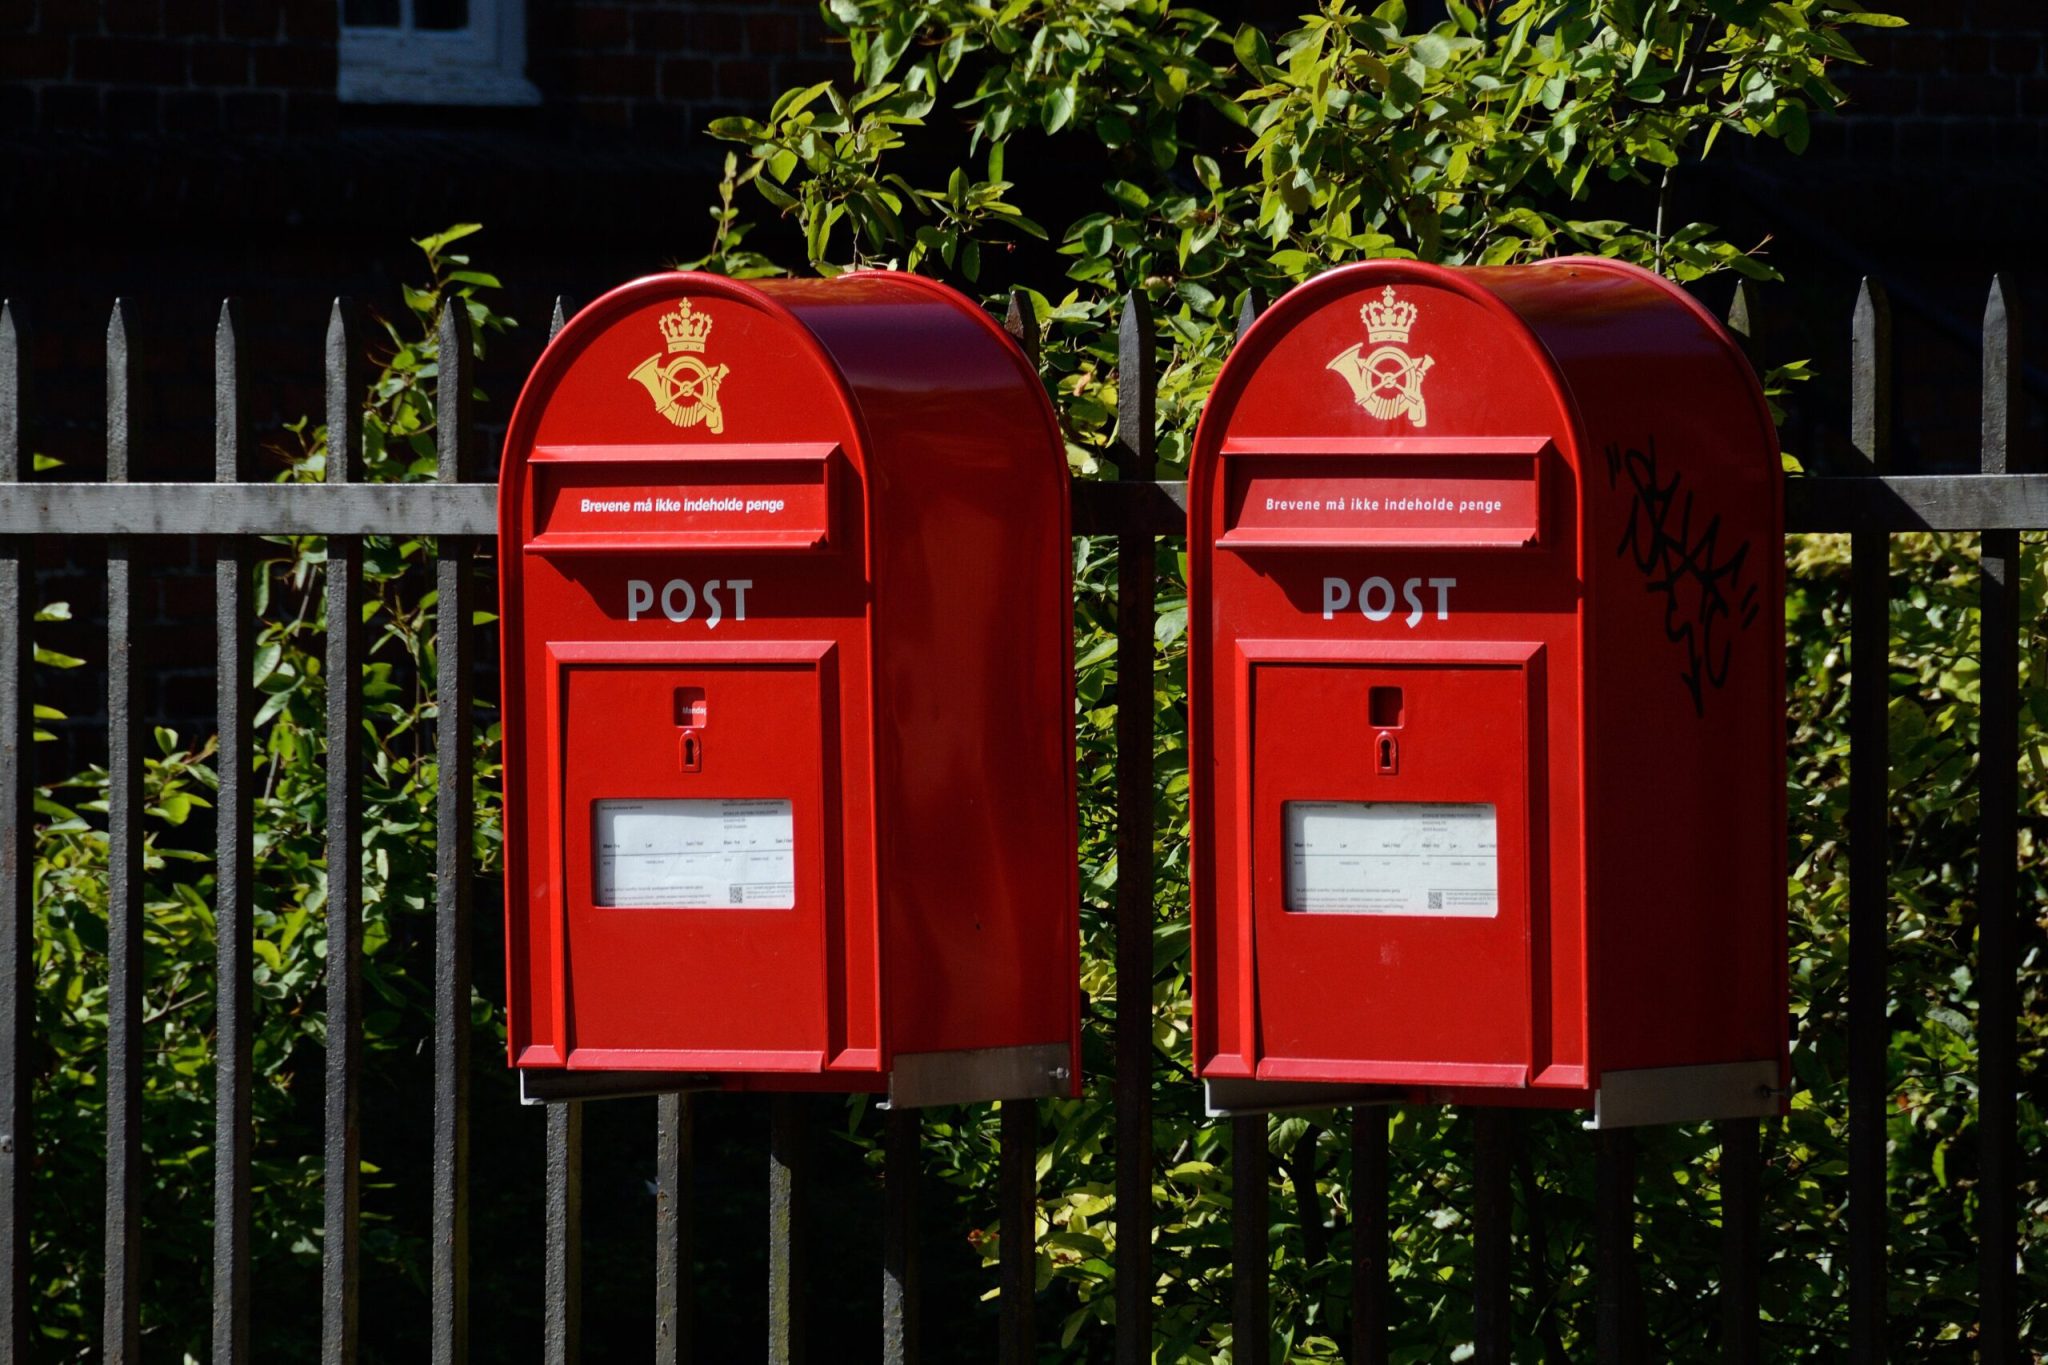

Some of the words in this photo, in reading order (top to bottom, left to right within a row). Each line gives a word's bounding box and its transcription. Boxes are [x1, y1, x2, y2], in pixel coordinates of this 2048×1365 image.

[580, 498, 631, 513] Brevene
[633, 497, 652, 513] må
[655, 498, 681, 512] ikke
[683, 498, 744, 512] indeholde
[745, 499, 785, 513] penge
[1265, 497, 1321, 511] Brevene
[1325, 496, 1346, 511] må
[1350, 497, 1380, 511] ikke
[1384, 497, 1454, 511] indeholde
[1458, 499, 1502, 514] penge
[627, 578, 753, 629] POST
[1322, 576, 1457, 629] POST
